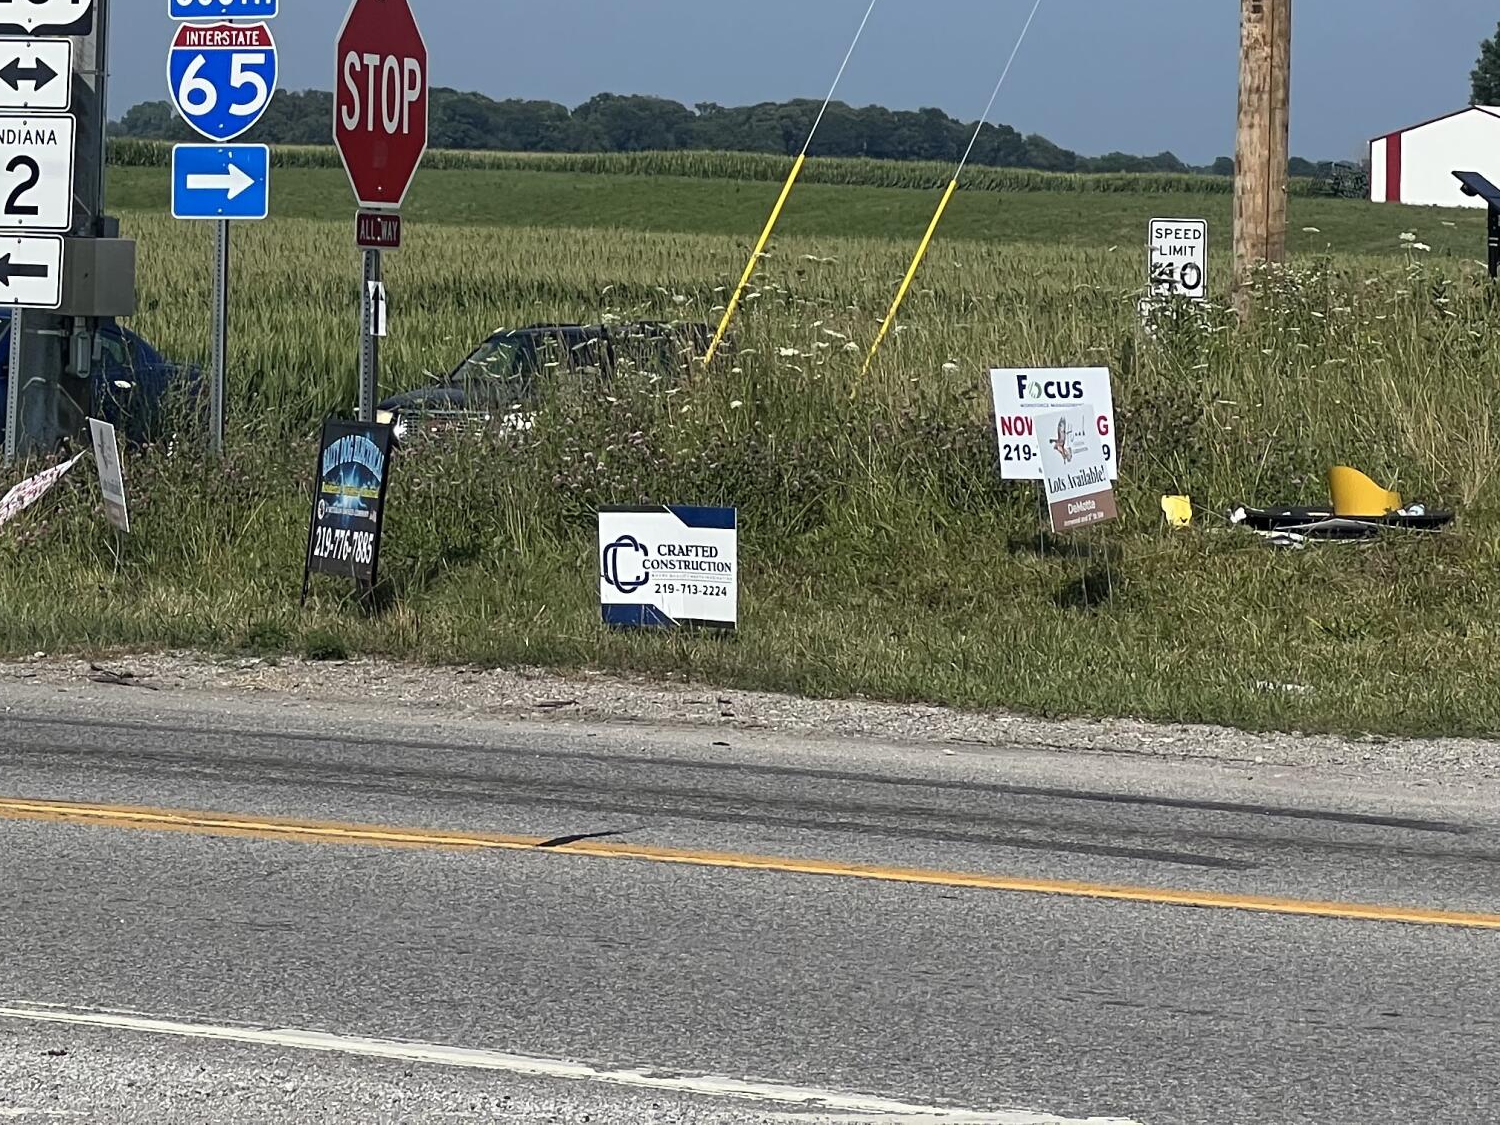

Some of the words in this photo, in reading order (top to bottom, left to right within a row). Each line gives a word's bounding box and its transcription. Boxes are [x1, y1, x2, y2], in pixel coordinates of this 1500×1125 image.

[186, 30, 260, 45] INTERSTATE
[178, 53, 268, 116] 65
[341, 50, 422, 135] STOP
[4, 155, 40, 216] 2
[359, 220, 375, 240] ALL
[381, 221, 398, 242] WAY
[1155, 228, 1202, 240] SPEED
[1159, 245, 1196, 257] LIMIT
[1047, 476, 1067, 494] Lots
[1067, 464, 1107, 489] Available!
[657, 544, 719, 559] CRAFTED
[642, 558, 732, 573] CONSTRUCTION
[654, 583, 727, 596] 219-713-2224
